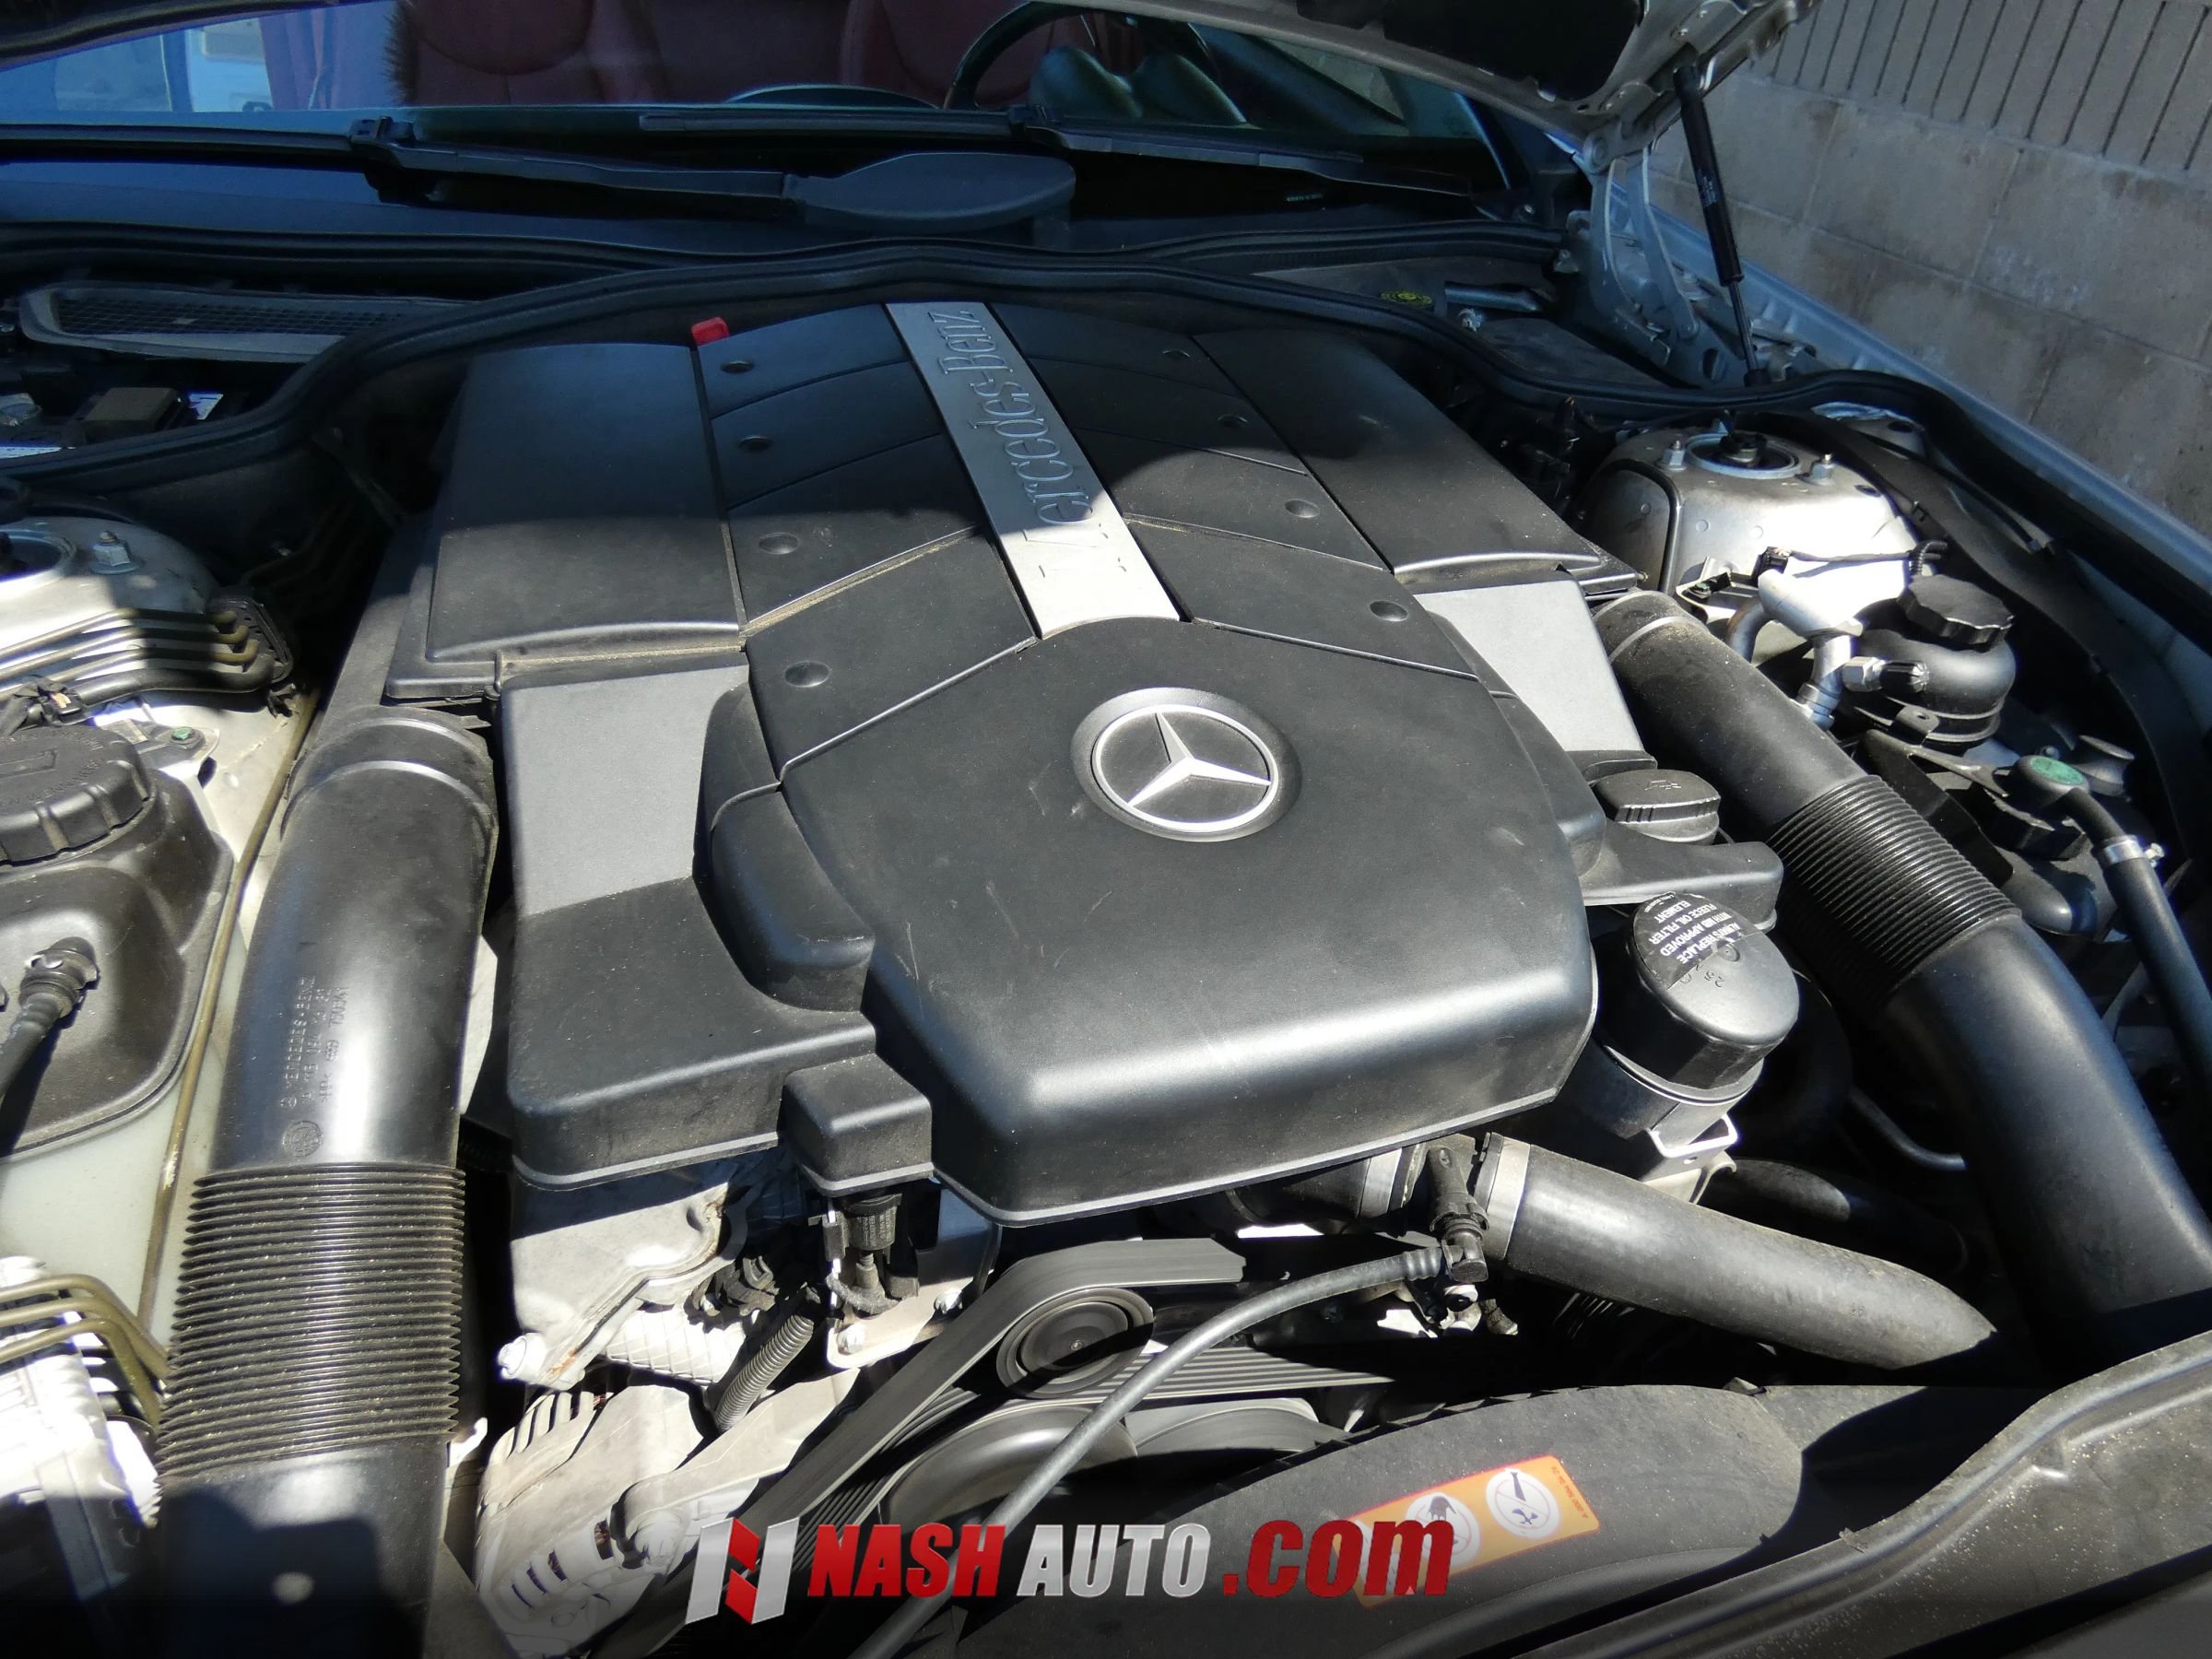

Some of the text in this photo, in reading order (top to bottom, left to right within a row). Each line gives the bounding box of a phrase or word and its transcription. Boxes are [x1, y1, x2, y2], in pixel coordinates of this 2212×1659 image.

[1653, 900, 1691, 924] ELEMENT
[1675, 914, 1692, 924] OIL
[1688, 903, 1717, 919] FLEECE
[1712, 912, 1733, 923] WITH
[1648, 922, 1680, 945] FILTER
[1660, 924, 1705, 956] APPROVED
[1677, 934, 1716, 964] REPLACE
